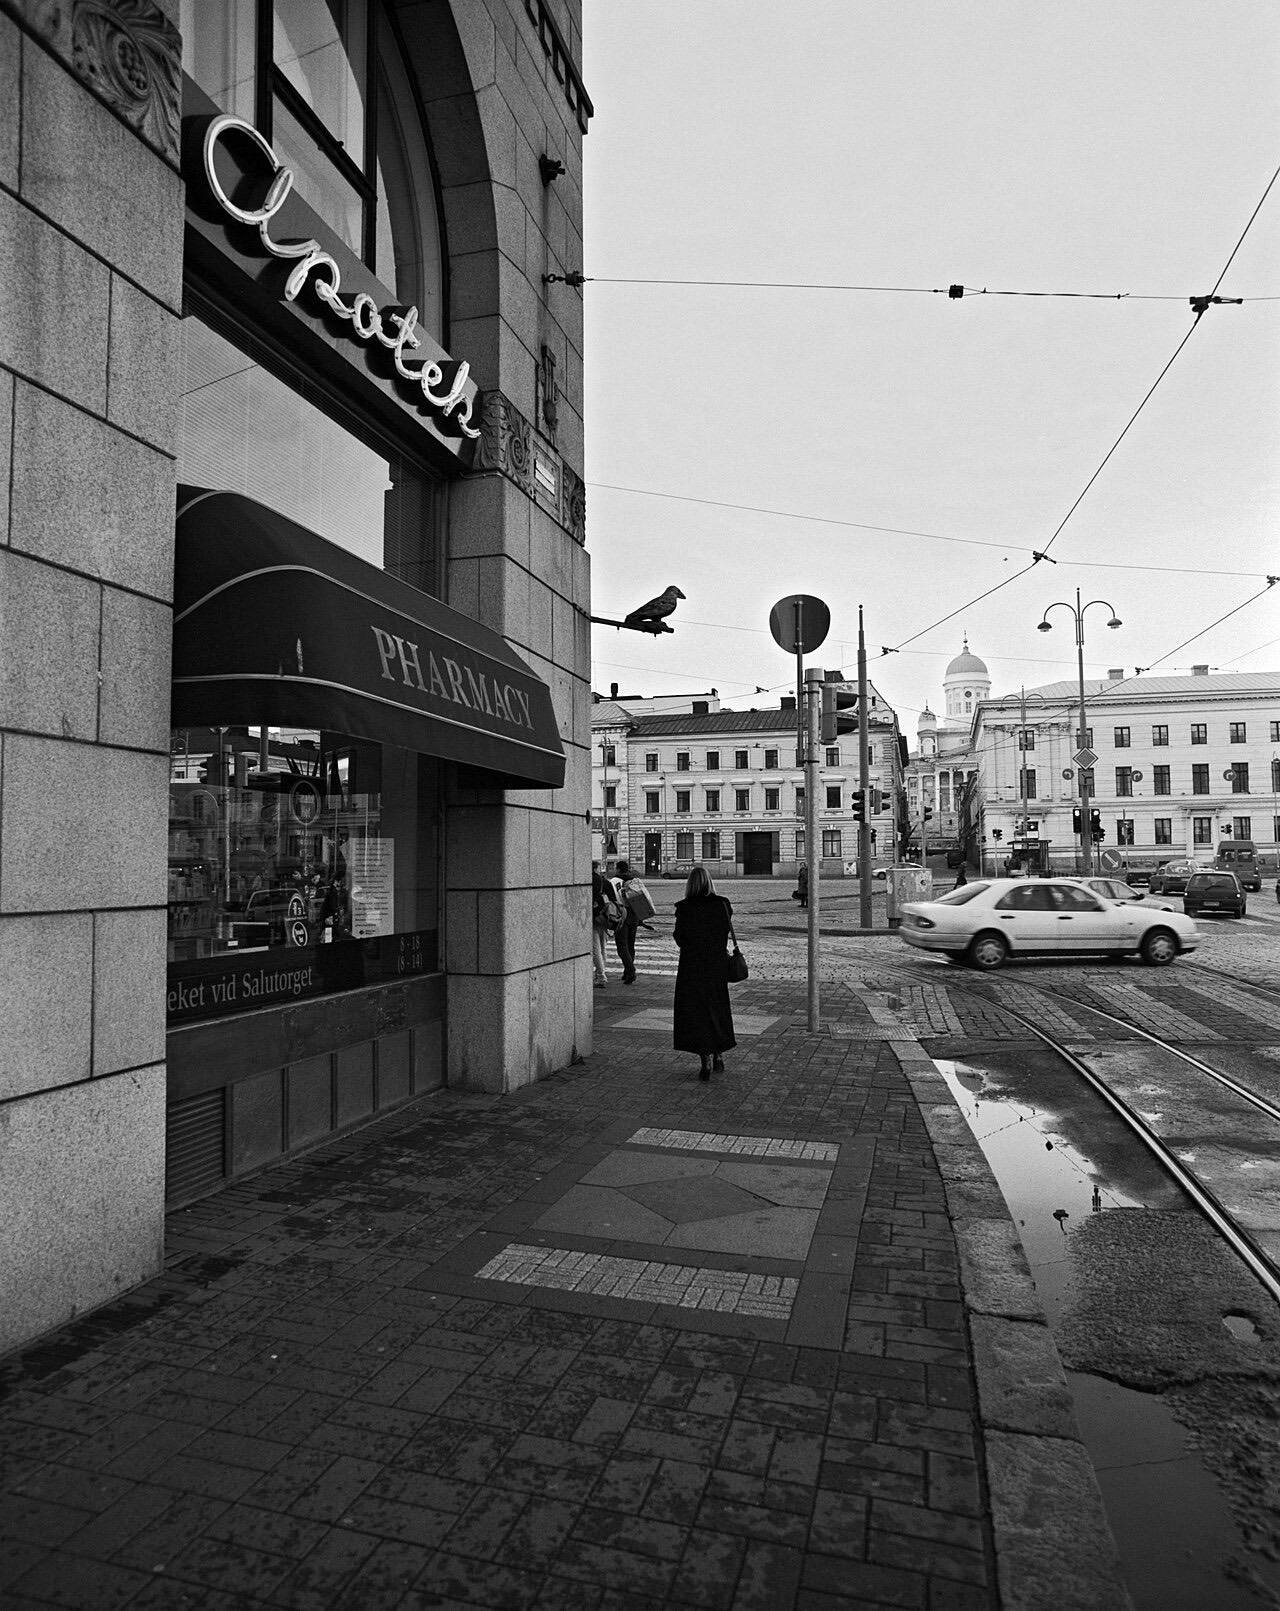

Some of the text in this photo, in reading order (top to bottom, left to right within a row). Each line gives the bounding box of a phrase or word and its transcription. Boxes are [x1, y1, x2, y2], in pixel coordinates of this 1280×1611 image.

[370, 625, 535, 731] PHARMACY
[211, 973, 237, 1004] vid
[242, 965, 313, 998] Salutorget
